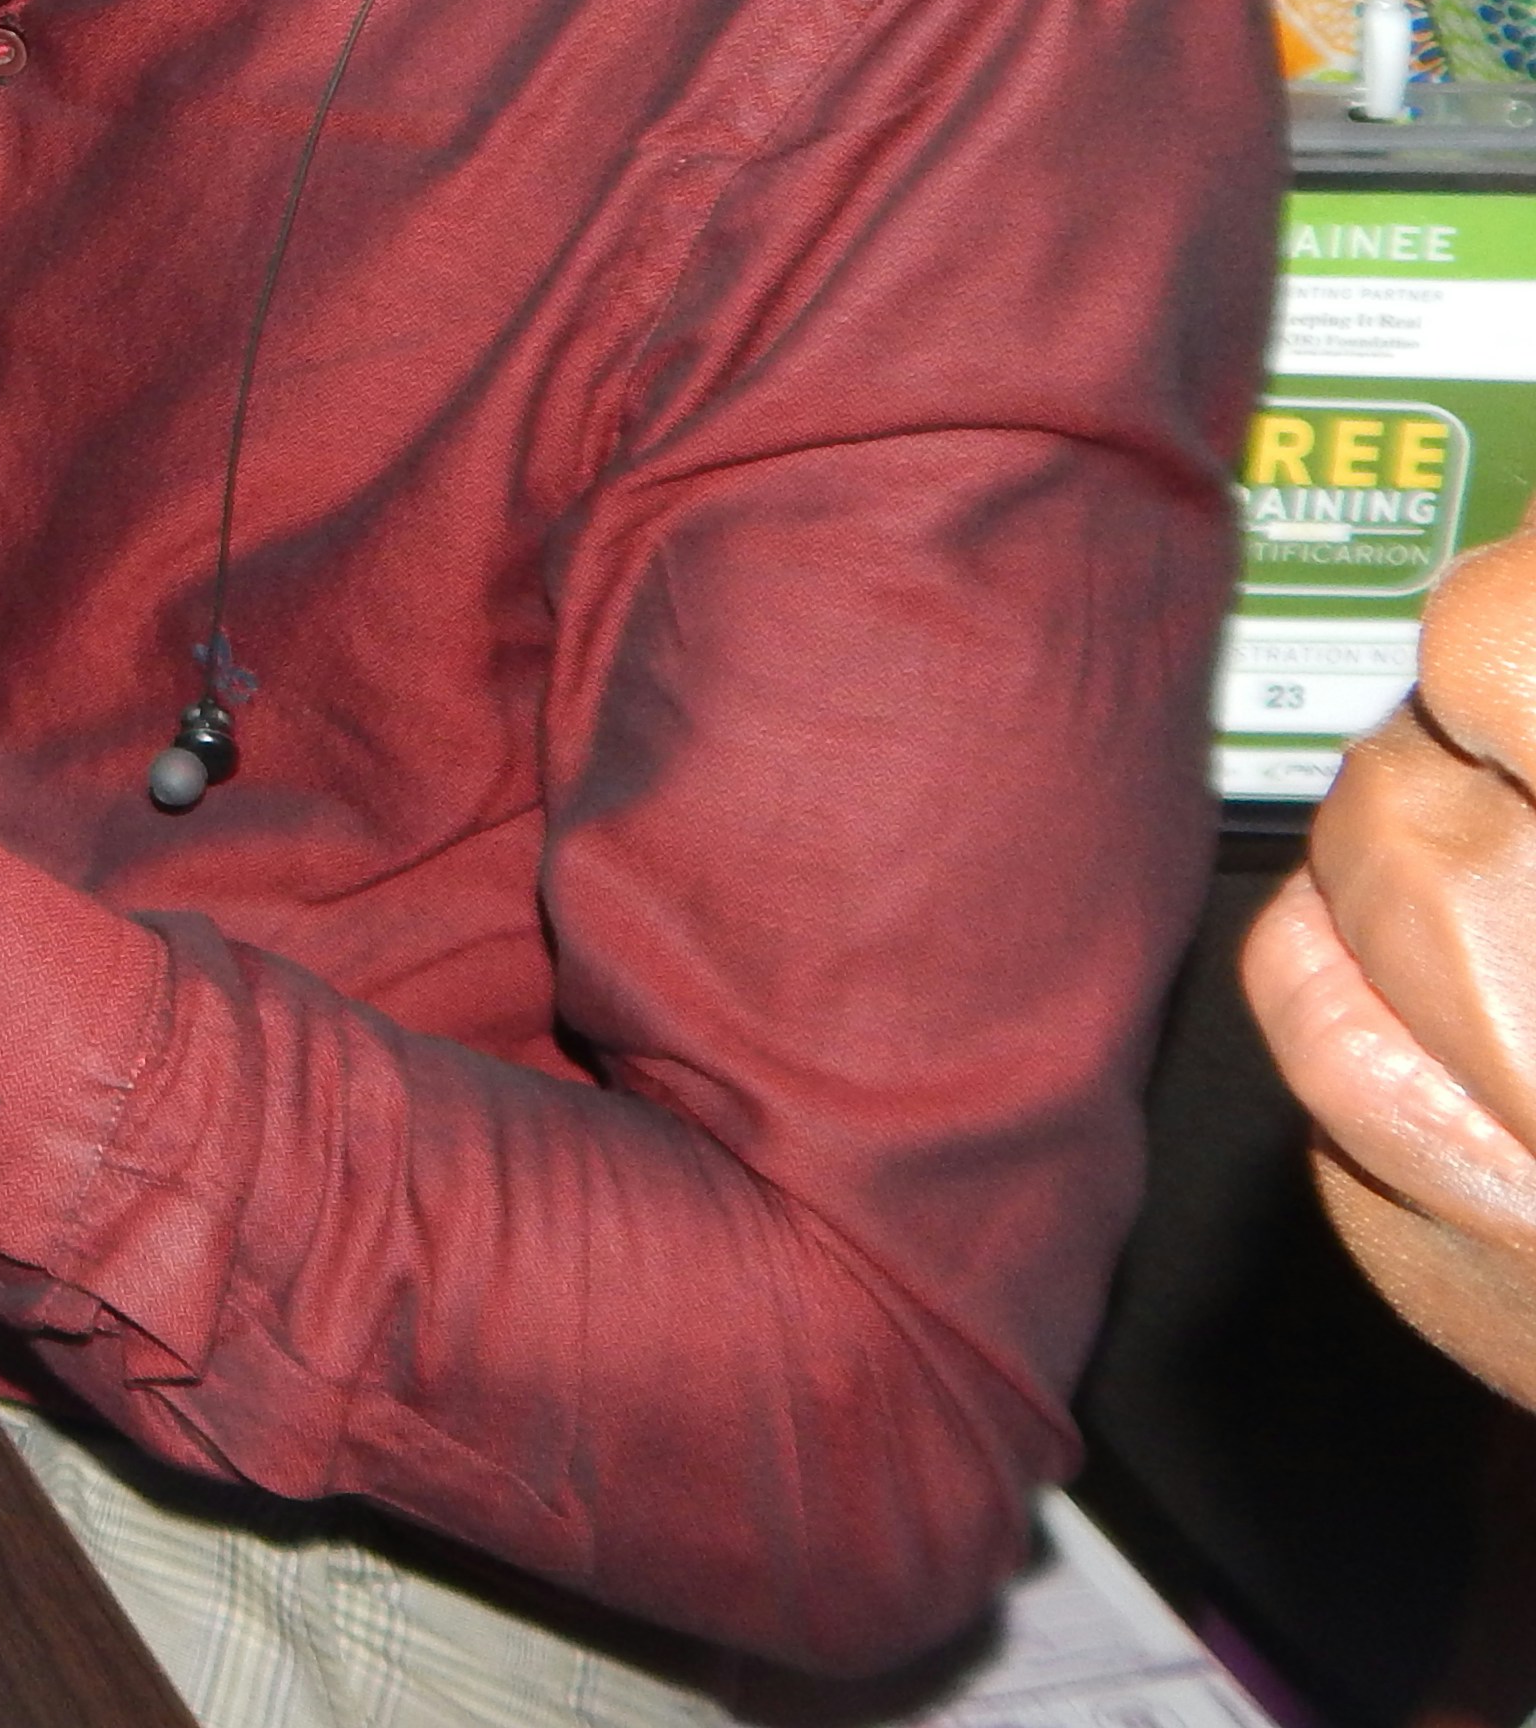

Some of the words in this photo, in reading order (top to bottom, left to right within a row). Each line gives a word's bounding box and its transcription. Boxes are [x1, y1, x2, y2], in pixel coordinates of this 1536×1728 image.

[1287, 223, 1459, 262] AINEE
[1252, 413, 1449, 490] REE
[1246, 542, 1431, 565] TIFICARION
[1264, 684, 1305, 709] 23
